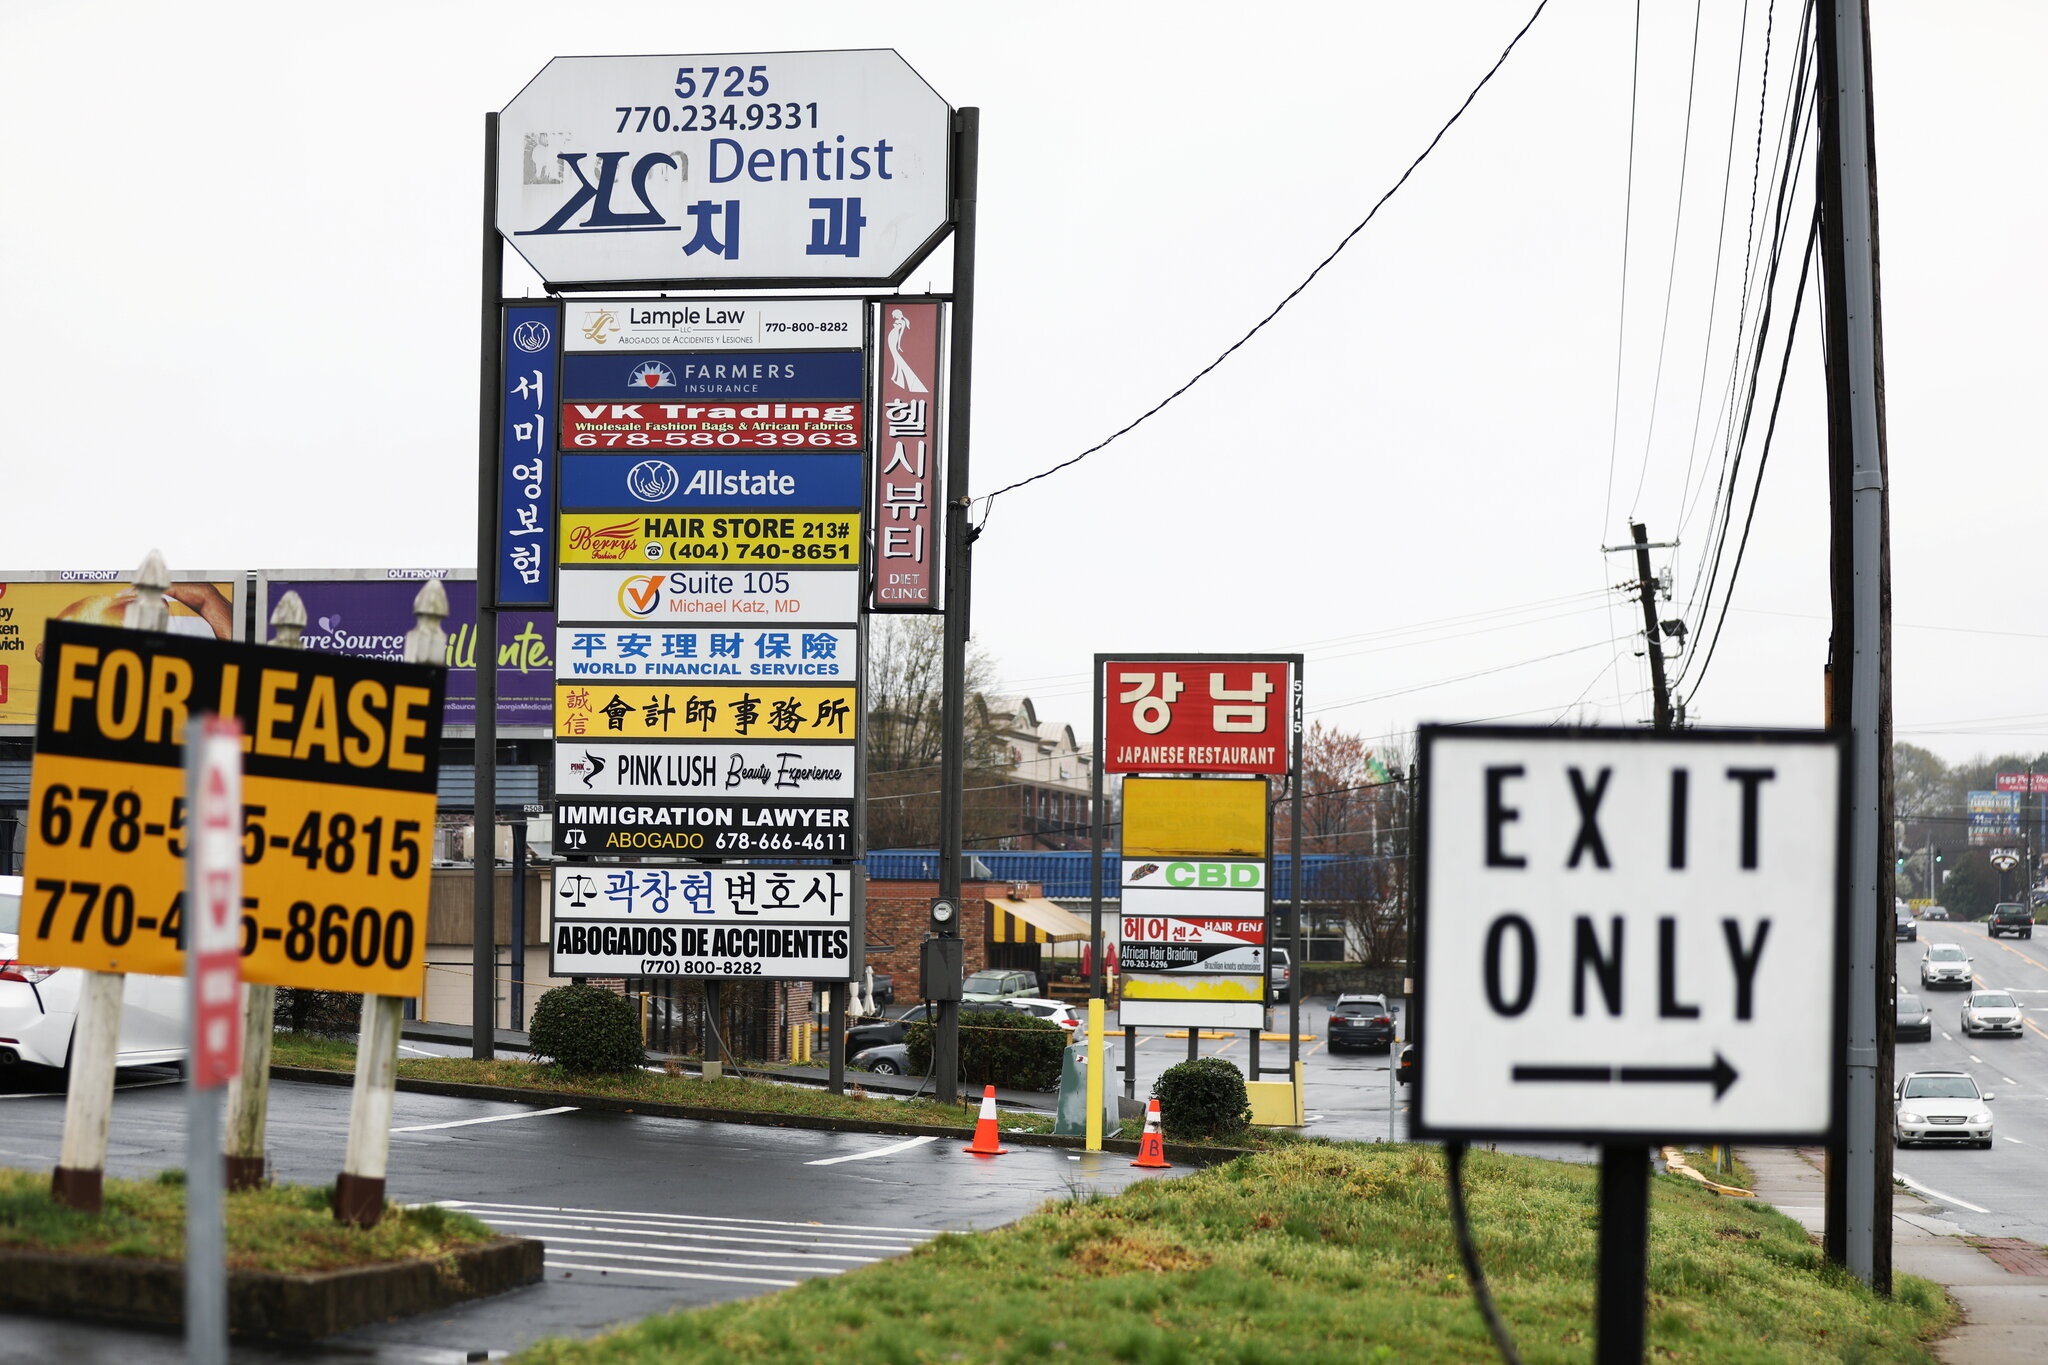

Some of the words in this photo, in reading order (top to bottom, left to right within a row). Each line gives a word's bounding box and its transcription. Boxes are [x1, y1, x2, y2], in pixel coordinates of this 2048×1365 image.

[674, 65, 769, 99] 5725
[615, 102, 818, 134] 770.234.9331
[709, 134, 894, 184] Dentist
[630, 307, 701, 328] Lample
[705, 307, 745, 324] Law
[765, 322, 848, 333] 770-800-8282
[685, 364, 795, 379] FARMERS
[685, 384, 759, 393] INSURANCE
[574, 405, 644, 419] VK
[660, 404, 855, 422] Trading
[575, 422, 641, 431] Wholesale
[645, 422, 697, 431] Fashion
[702, 422, 734, 432] Bags
[738, 422, 748, 431] &
[752, 422, 800, 431] African
[804, 422, 854, 431] Fabrics
[573, 432, 858, 447] 678-580-3963
[684, 469, 795, 496] Allstate
[882, 398, 928, 563] 헬시뷰티
[644, 518, 705, 538] HAIR
[712, 518, 795, 539] STORE
[802, 522, 850, 539] 213#
[569, 525, 638, 559] Berrys
[669, 541, 728, 560] (404)
[736, 543, 850, 560] 740-8651
[591, 550, 617, 559] Fashion
[62, 571, 117, 580] OUTFRONT
[388, 569, 447, 579] OUTFRONT
[669, 571, 734, 594] Suite
[743, 571, 790, 594] 105
[889, 573, 920, 585] DIET
[881, 587, 927, 599] CLINIC
[669, 599, 727, 613] Michael
[732, 599, 769, 614] Katz,
[774, 599, 801, 613] MD
[571, 632, 840, 660] 平安理財保險
[573, 662, 637, 675] WORLD
[645, 663, 742, 675] FINANCIAL
[750, 663, 840, 675] SERVICES
[53, 643, 194, 748] FOR
[219, 664, 431, 773] LEASE
[563, 687, 593, 735] 誠信
[1119, 672, 1275, 734] 강남
[1293, 680, 1302, 734] 5715
[598, 692, 851, 736] 會計師事務所
[1117, 746, 1185, 764] JAPANESE
[1188, 746, 1275, 765] RESTAURANT
[571, 763, 584, 771] PINK
[618, 755, 663, 786] PINK
[666, 755, 717, 787] LUSH
[725, 752, 771, 790] Beauty
[774, 752, 843, 790] Experience
[559, 805, 732, 827] IMMIGRATION
[741, 807, 850, 828] LAWYER
[1484, 764, 1776, 871] EXIT
[39, 783, 420, 881] 678-55-4815
[606, 832, 704, 849] ABOGADO
[715, 833, 846, 851] 678-666-4611
[1165, 862, 1261, 887] CBD
[603, 870, 715, 914] 곽창현
[725, 871, 843, 916] 변호사
[34, 879, 414, 970] 770-45-8600
[1204, 922, 1232, 932] HAIR
[1236, 922, 1263, 932] SENS
[557, 926, 677, 957] ABOGADOS
[681, 928, 710, 957] DE
[711, 929, 849, 959] ACCIDENTES
[1121, 946, 1148, 960] African
[1150, 947, 1165, 960] Hair
[1167, 947, 1197, 963] Braiding
[1121, 960, 1168, 968] 470-263-6296
[640, 959, 681, 975] (770)
[683, 960, 762, 975] 800-8282
[1482, 912, 1771, 1021] ONLY
